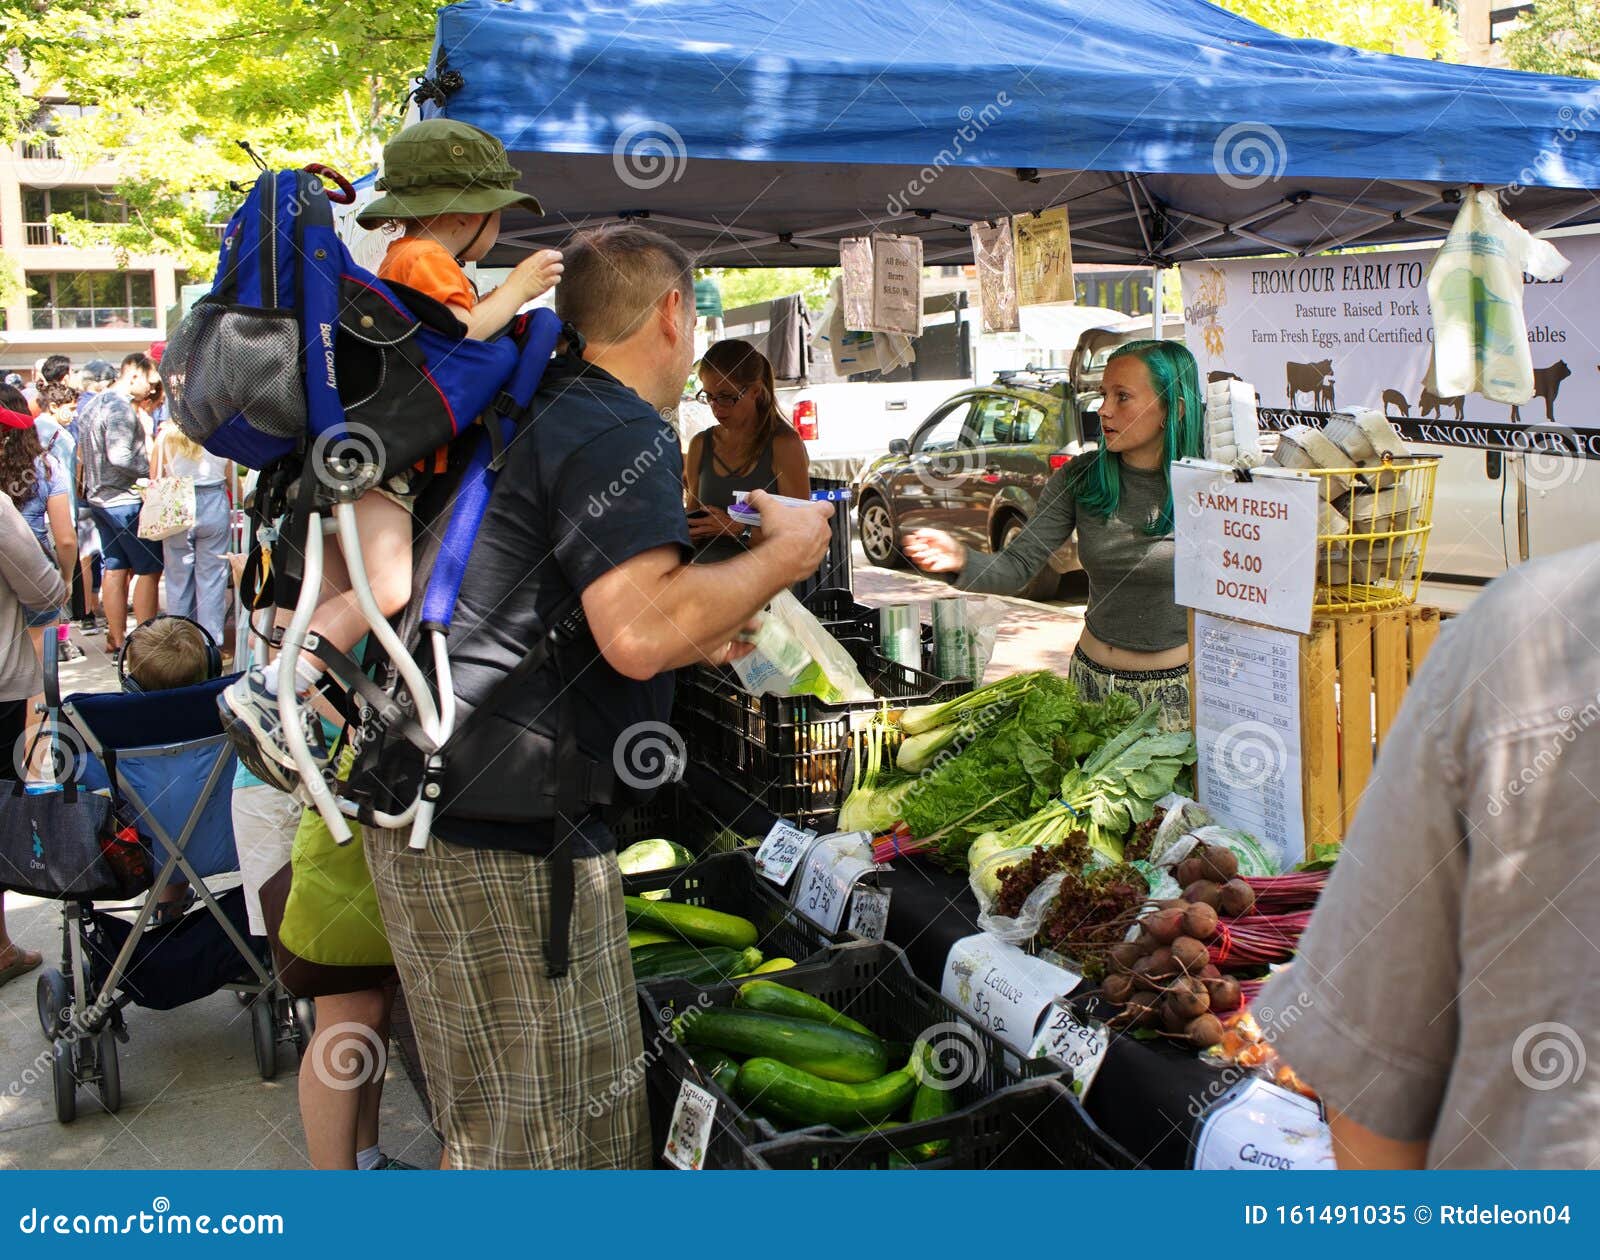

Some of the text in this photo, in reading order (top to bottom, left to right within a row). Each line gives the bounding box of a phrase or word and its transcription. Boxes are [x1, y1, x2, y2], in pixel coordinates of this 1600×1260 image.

[1252, 262, 1422, 294] FROM OUR FARM TO
[1296, 303, 1336, 317] Pasture
[1343, 302, 1382, 317] Raised
[1391, 300, 1419, 316] Pork
[1252, 329, 1277, 343] Farm
[1280, 328, 1308, 343] Fresh
[1312, 329, 1341, 348] Eggs,
[1344, 328, 1366, 343] and
[1369, 327, 1422, 343] Certified
[1528, 326, 1566, 342] ables
[320, 323, 337, 388] Back Country
[1419, 424, 1490, 446] KNOW
[1494, 430, 1569, 453] YOUR
[1196, 492, 1288, 520] FARM FRESH
[1224, 520, 1260, 541] EGGS
[1223, 550, 1262, 573] $4.00
[1216, 579, 1267, 604] DOZEN
[984, 967, 1023, 1004] Lettuce
[1050, 1011, 1103, 1056] Beets
[680, 1084, 714, 1116] Squash
[1239, 1143, 1295, 1170] Carrots
